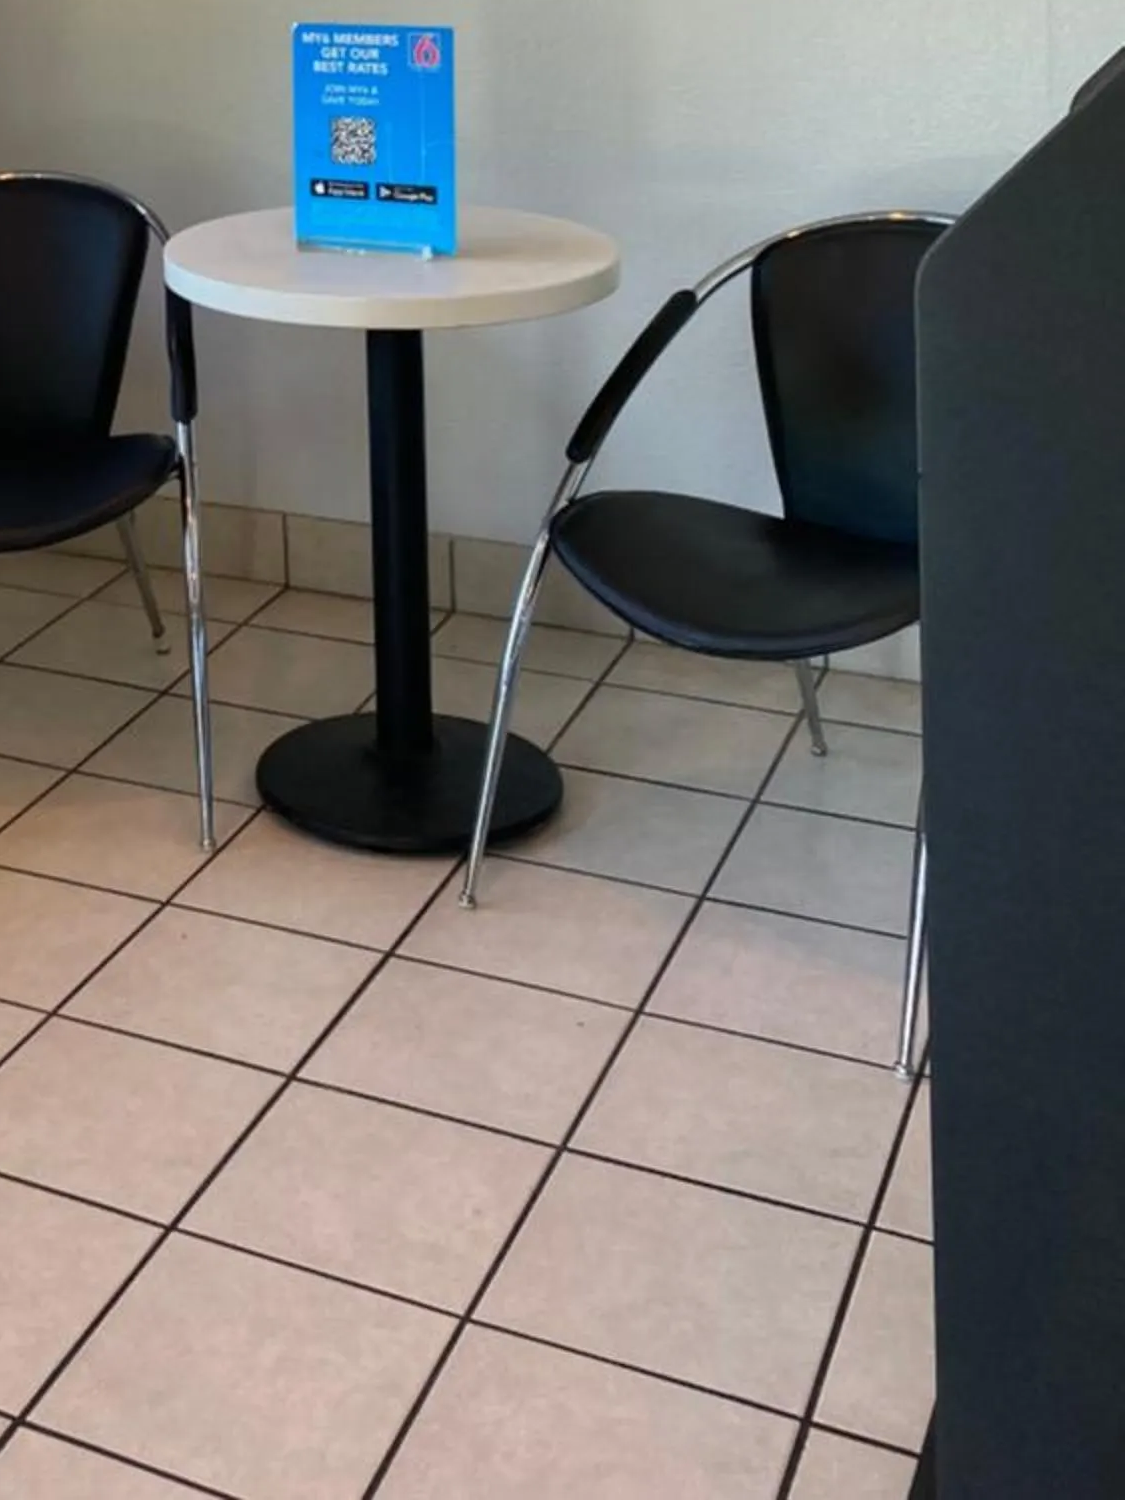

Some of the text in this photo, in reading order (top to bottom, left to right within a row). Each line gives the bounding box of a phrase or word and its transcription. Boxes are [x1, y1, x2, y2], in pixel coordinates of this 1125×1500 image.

[333, 32, 399, 47] MEMBERS
[320, 46, 379, 60] GET OUR
[413, 32, 441, 68] 6
[313, 60, 388, 75] BEST RATES
